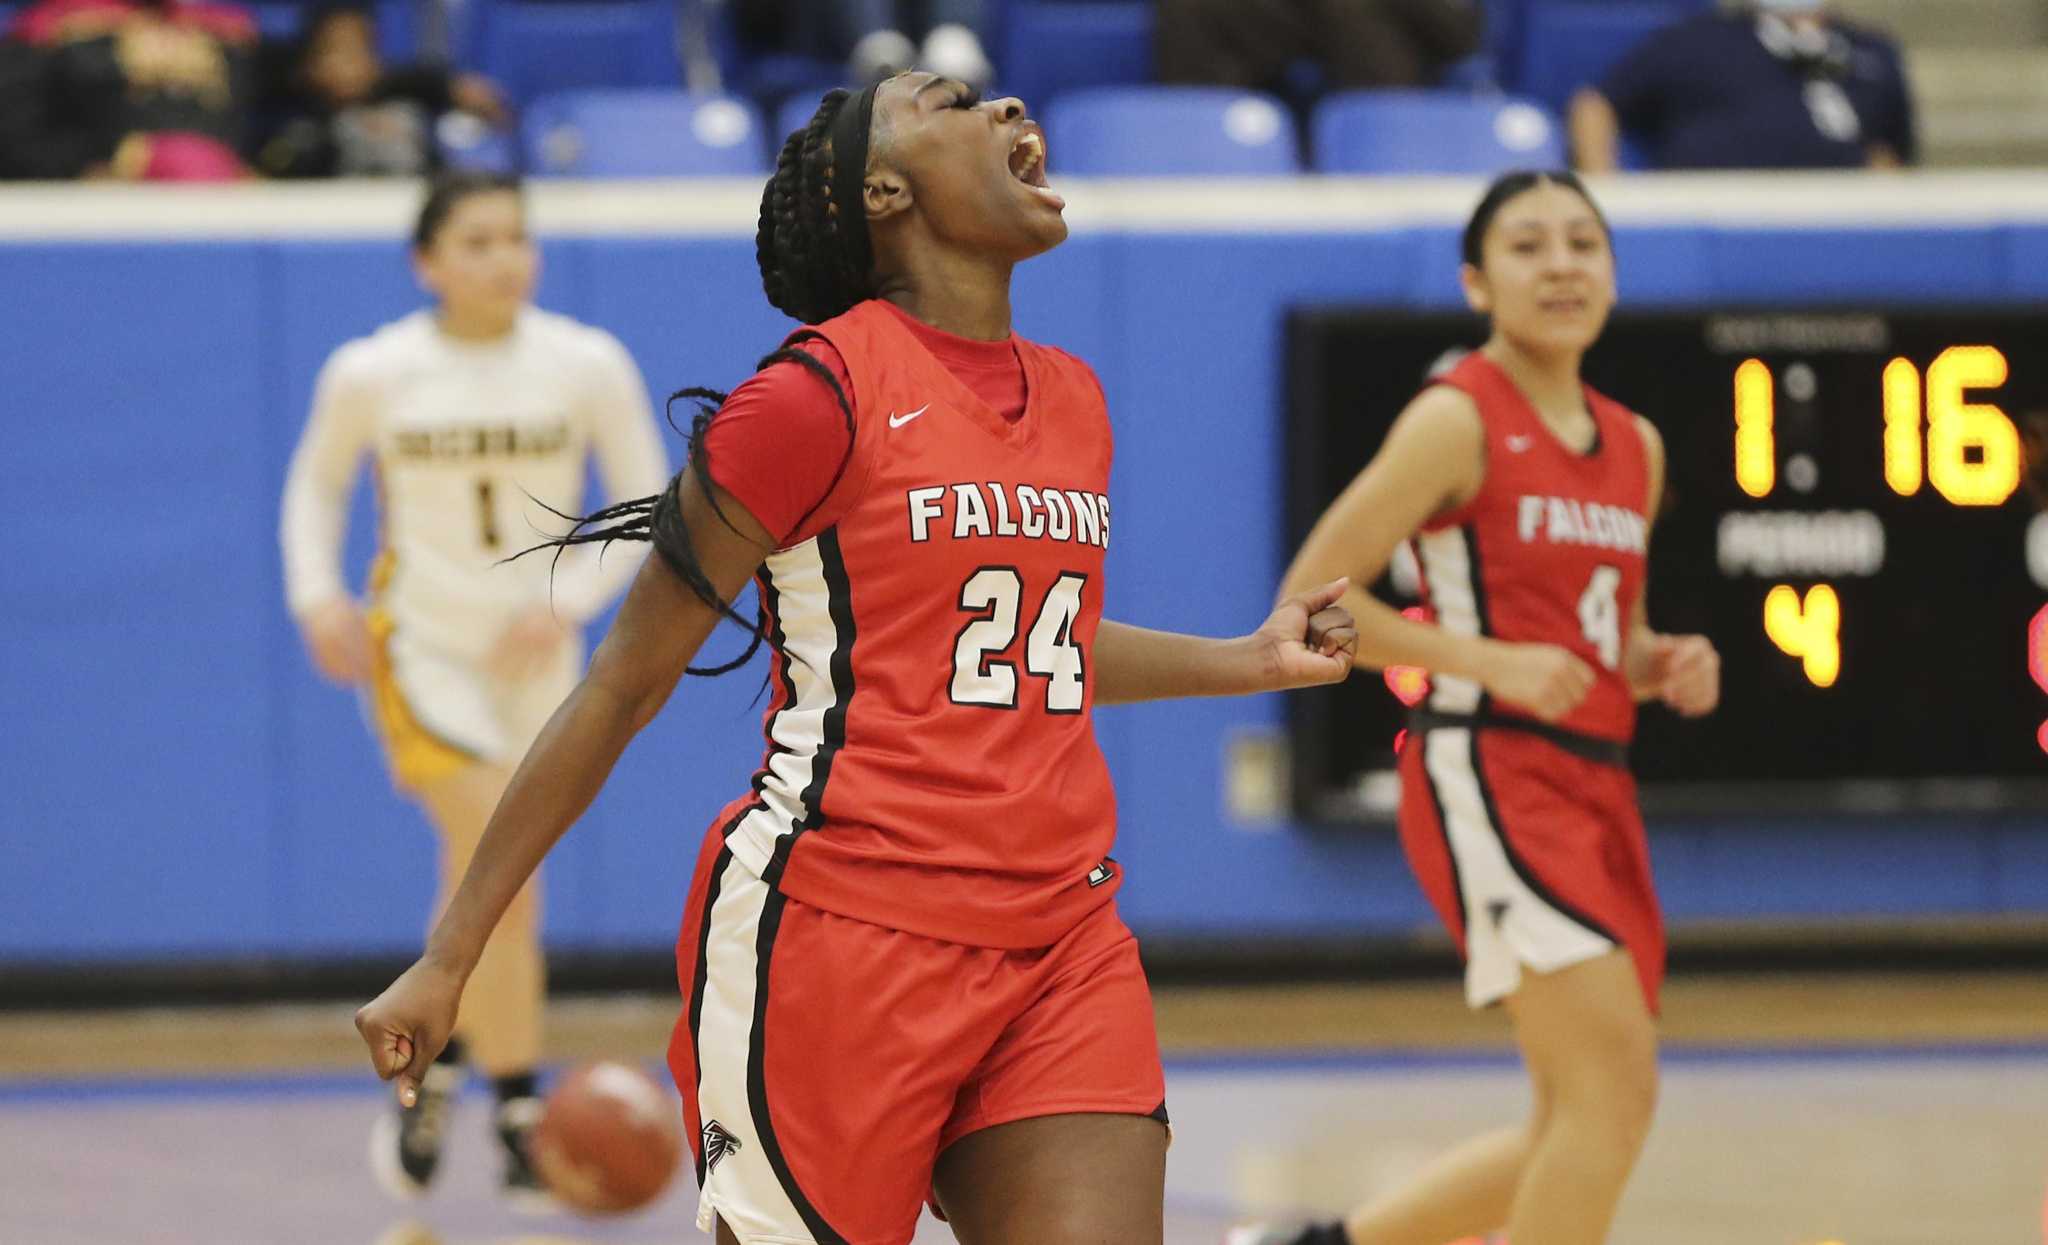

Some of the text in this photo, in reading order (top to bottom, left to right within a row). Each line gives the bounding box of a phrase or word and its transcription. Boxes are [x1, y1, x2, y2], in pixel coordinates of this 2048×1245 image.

[907, 481, 1110, 550] FALCONS
[949, 565, 1088, 714] 24
[1578, 565, 1622, 672] 4
[1764, 584, 1840, 688] 4
